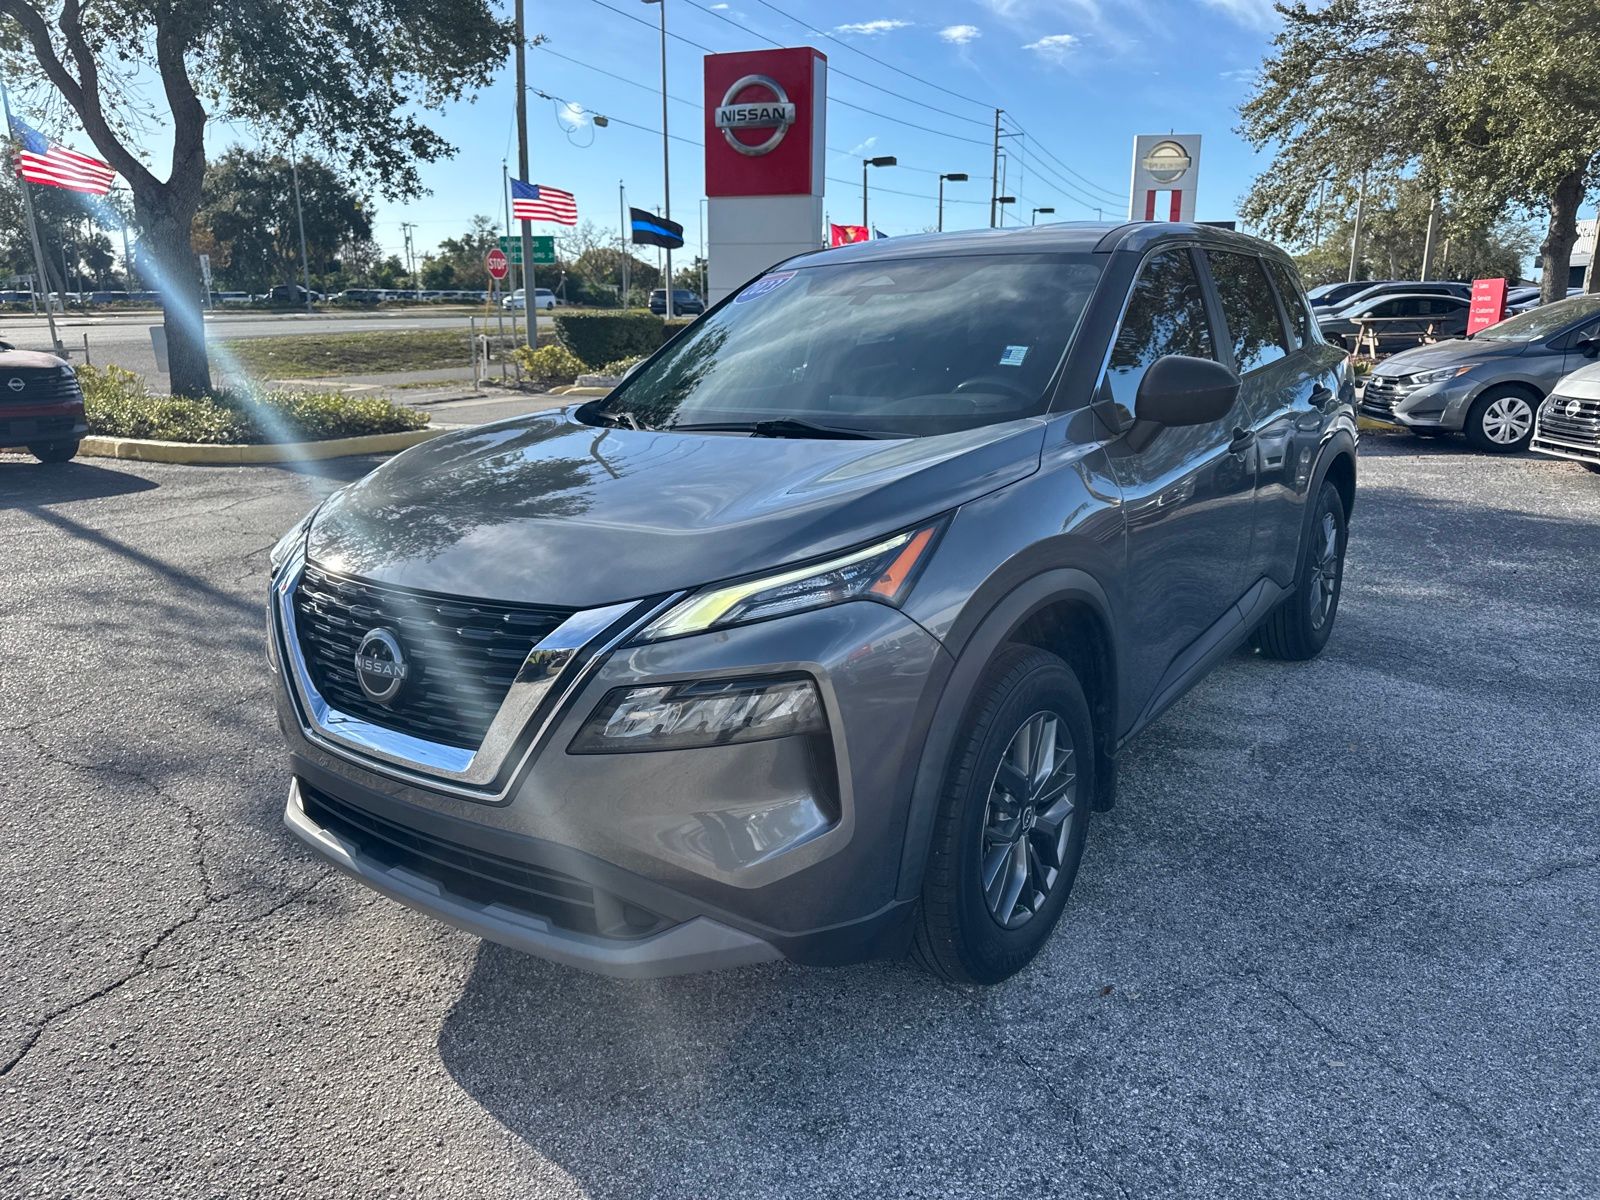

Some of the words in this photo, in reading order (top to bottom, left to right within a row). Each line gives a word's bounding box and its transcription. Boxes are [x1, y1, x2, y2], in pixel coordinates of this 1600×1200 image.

[721, 107, 786, 123] NISSAN
[488, 258, 507, 269] STOP
[355, 653, 405, 677] NISSAN
